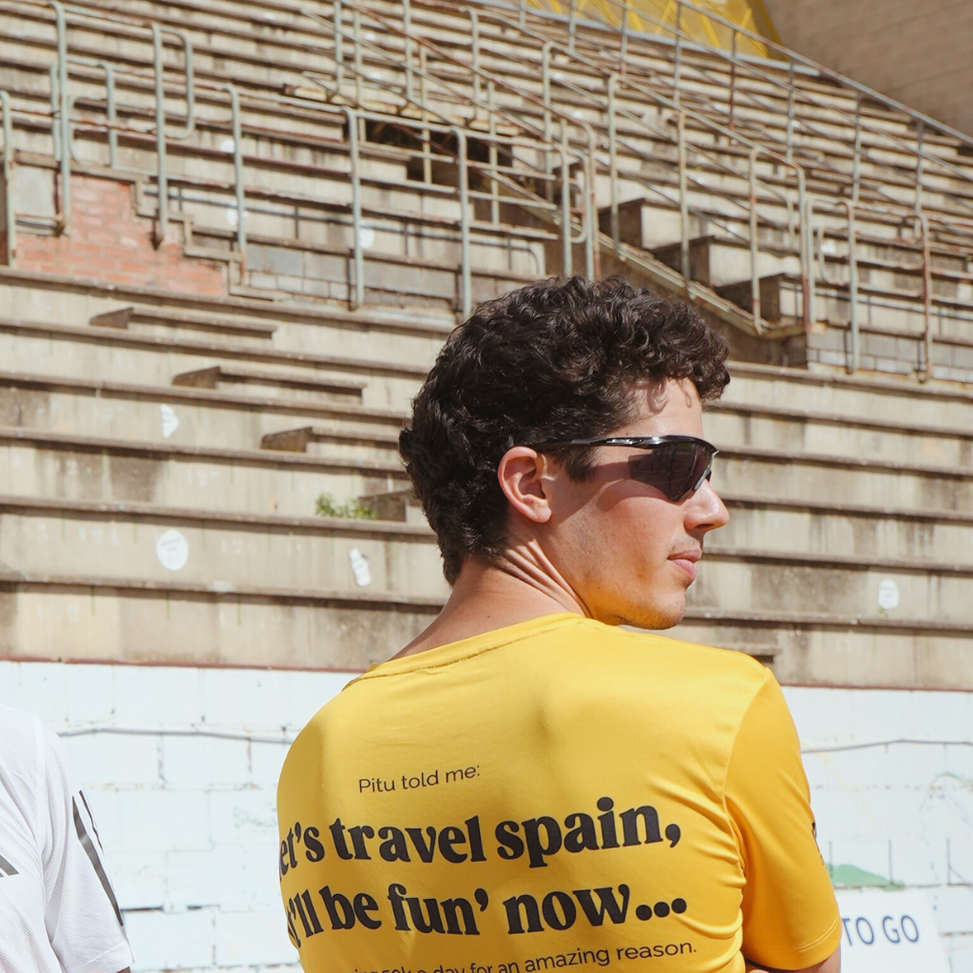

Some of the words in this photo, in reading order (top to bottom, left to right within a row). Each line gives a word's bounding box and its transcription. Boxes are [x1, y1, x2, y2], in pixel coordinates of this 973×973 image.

[358, 778, 396, 794] Pitu
[401, 770, 440, 790] told
[445, 765, 481, 782] me:
[329, 815, 487, 863] travel
[496, 797, 682, 868] spain,
[319, 885, 382, 930] be
[503, 884, 687, 936] now...
[842, 917, 874, 946] TO
[882, 914, 920, 944] GO
[524, 946, 611, 973] amazing
[616, 939, 698, 961] reason.
